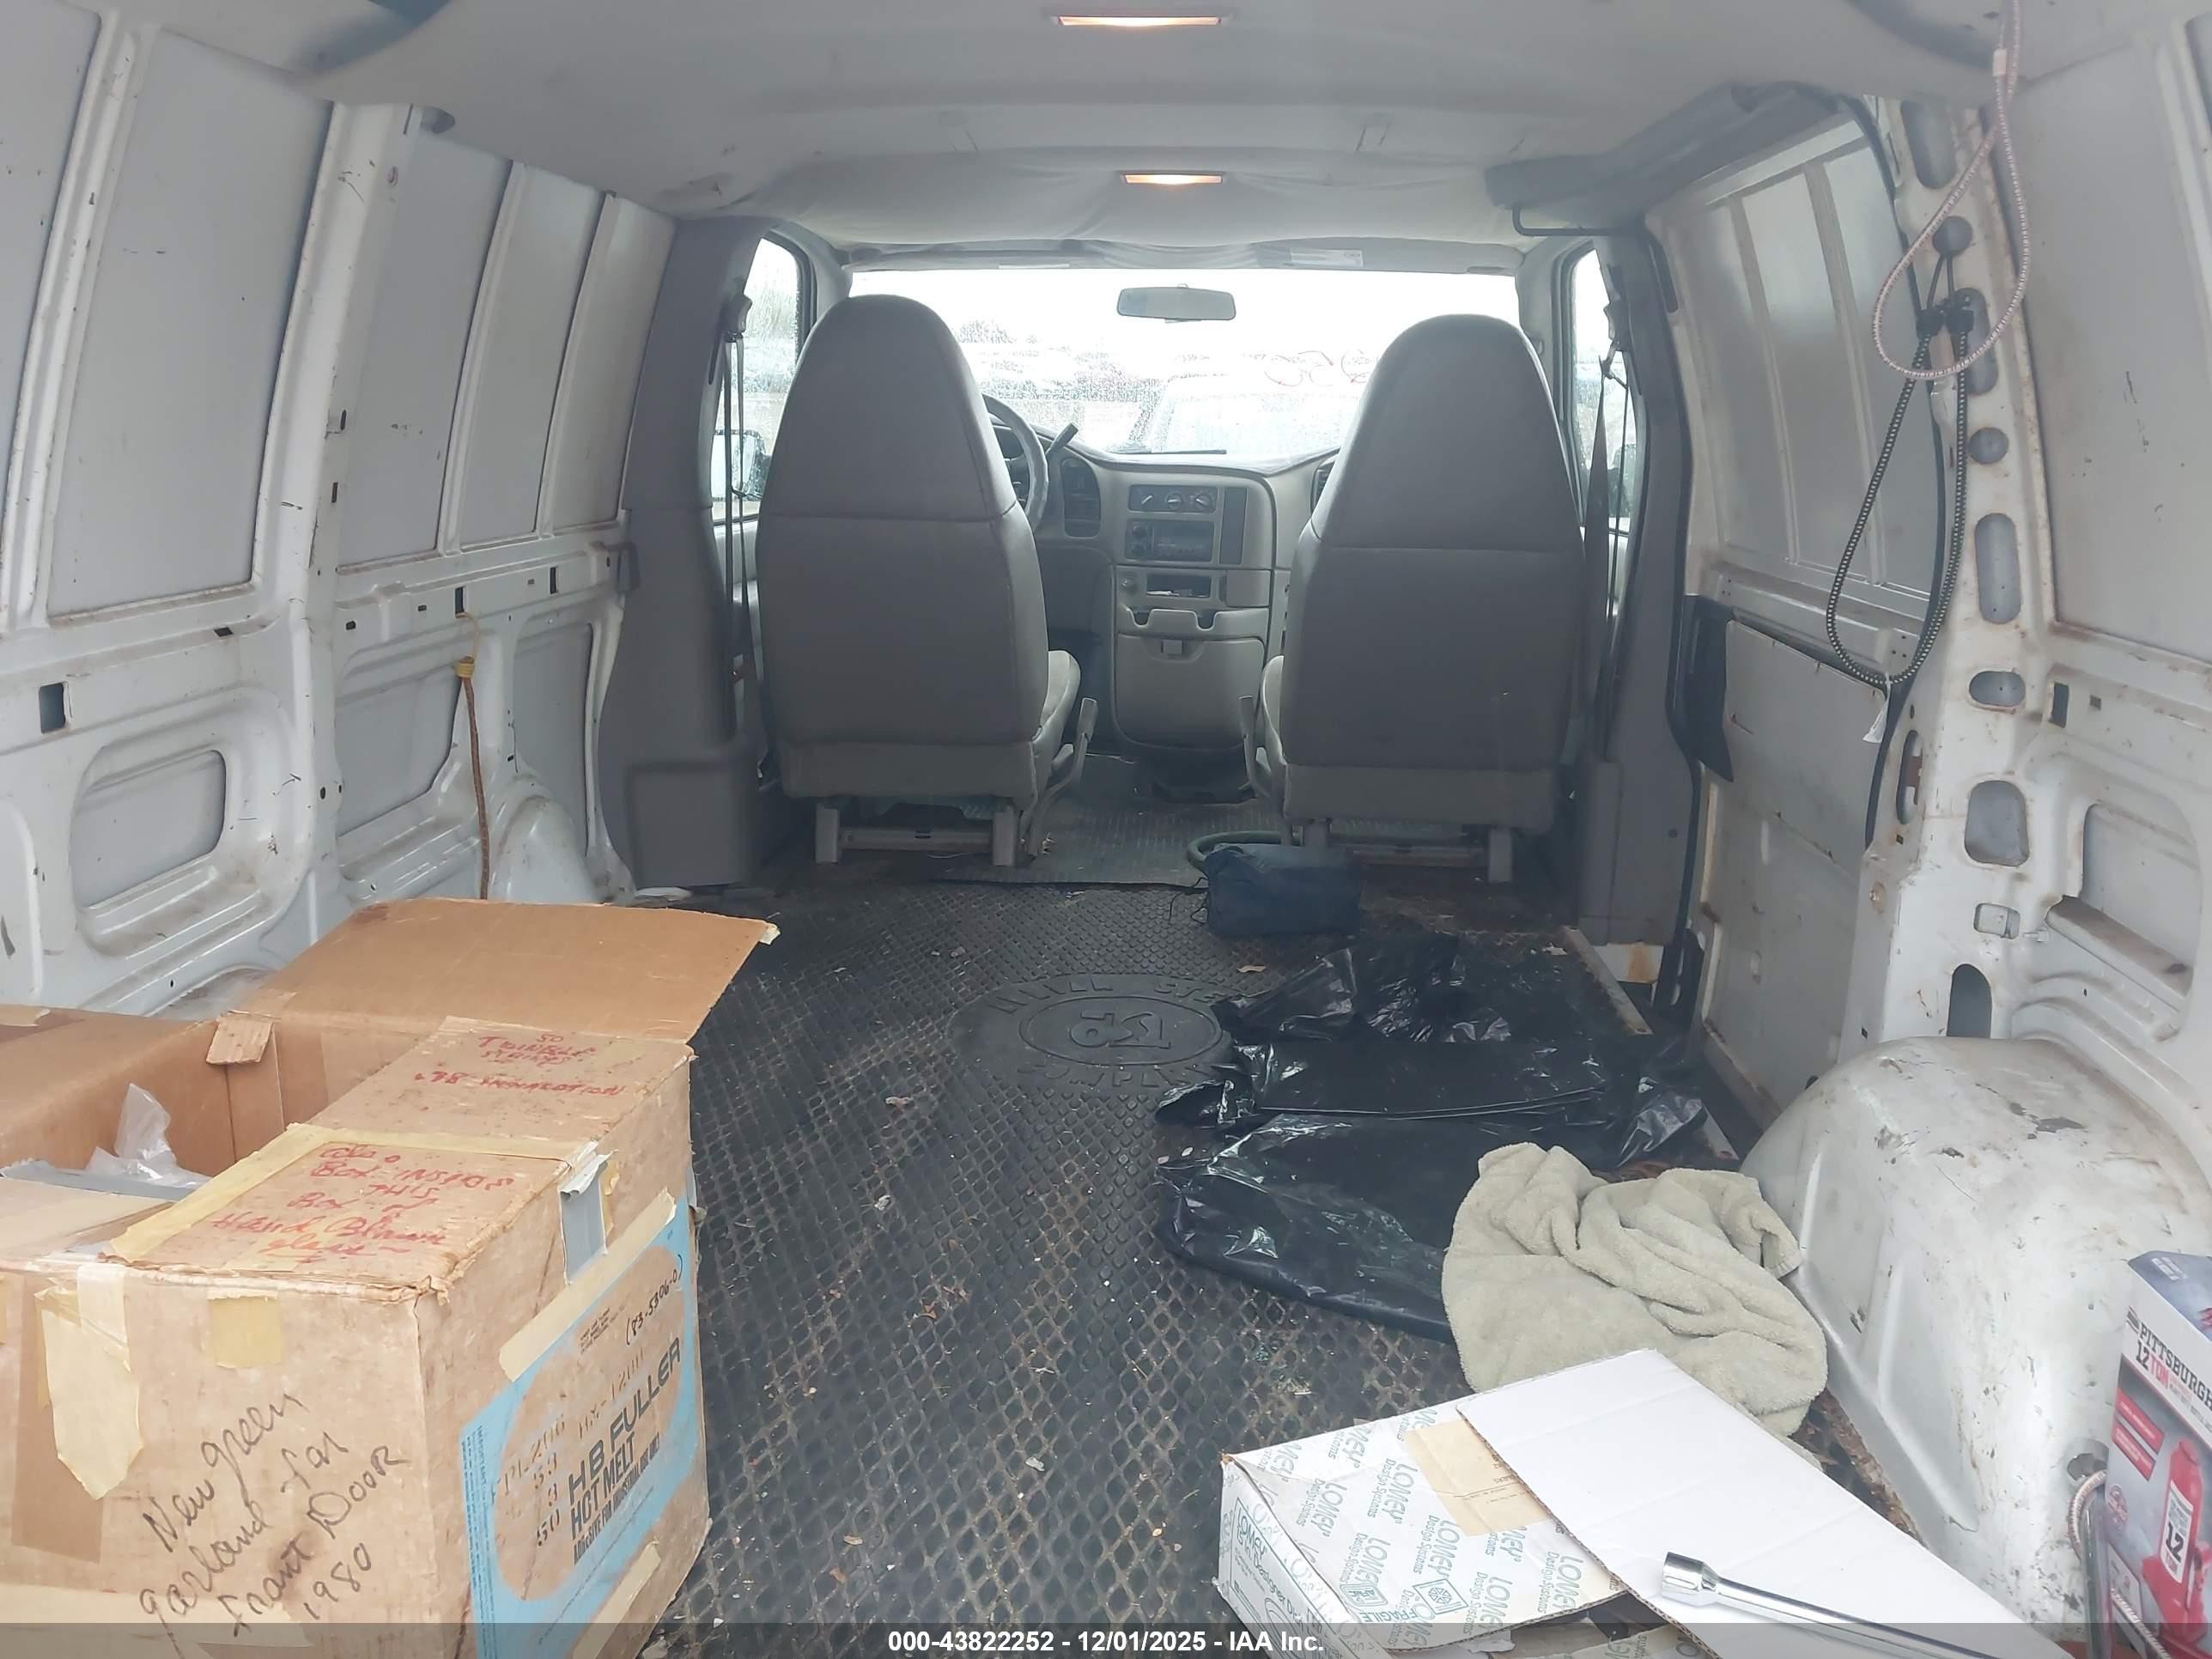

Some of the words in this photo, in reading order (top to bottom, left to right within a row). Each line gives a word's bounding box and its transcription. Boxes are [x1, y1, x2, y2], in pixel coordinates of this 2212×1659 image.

[2136, 1340, 2150, 1371] 12
[610, 1336, 682, 1443] FULLER
[601, 1431, 637, 1502] MELT
[143, 1477, 215, 1553] New
[2166, 1522, 2184, 1563] 12
[303, 1542, 374, 1620] 1980
[1479, 1576, 1514, 1631] LOME
[1359, 1607, 1419, 1623] FRAGILE
